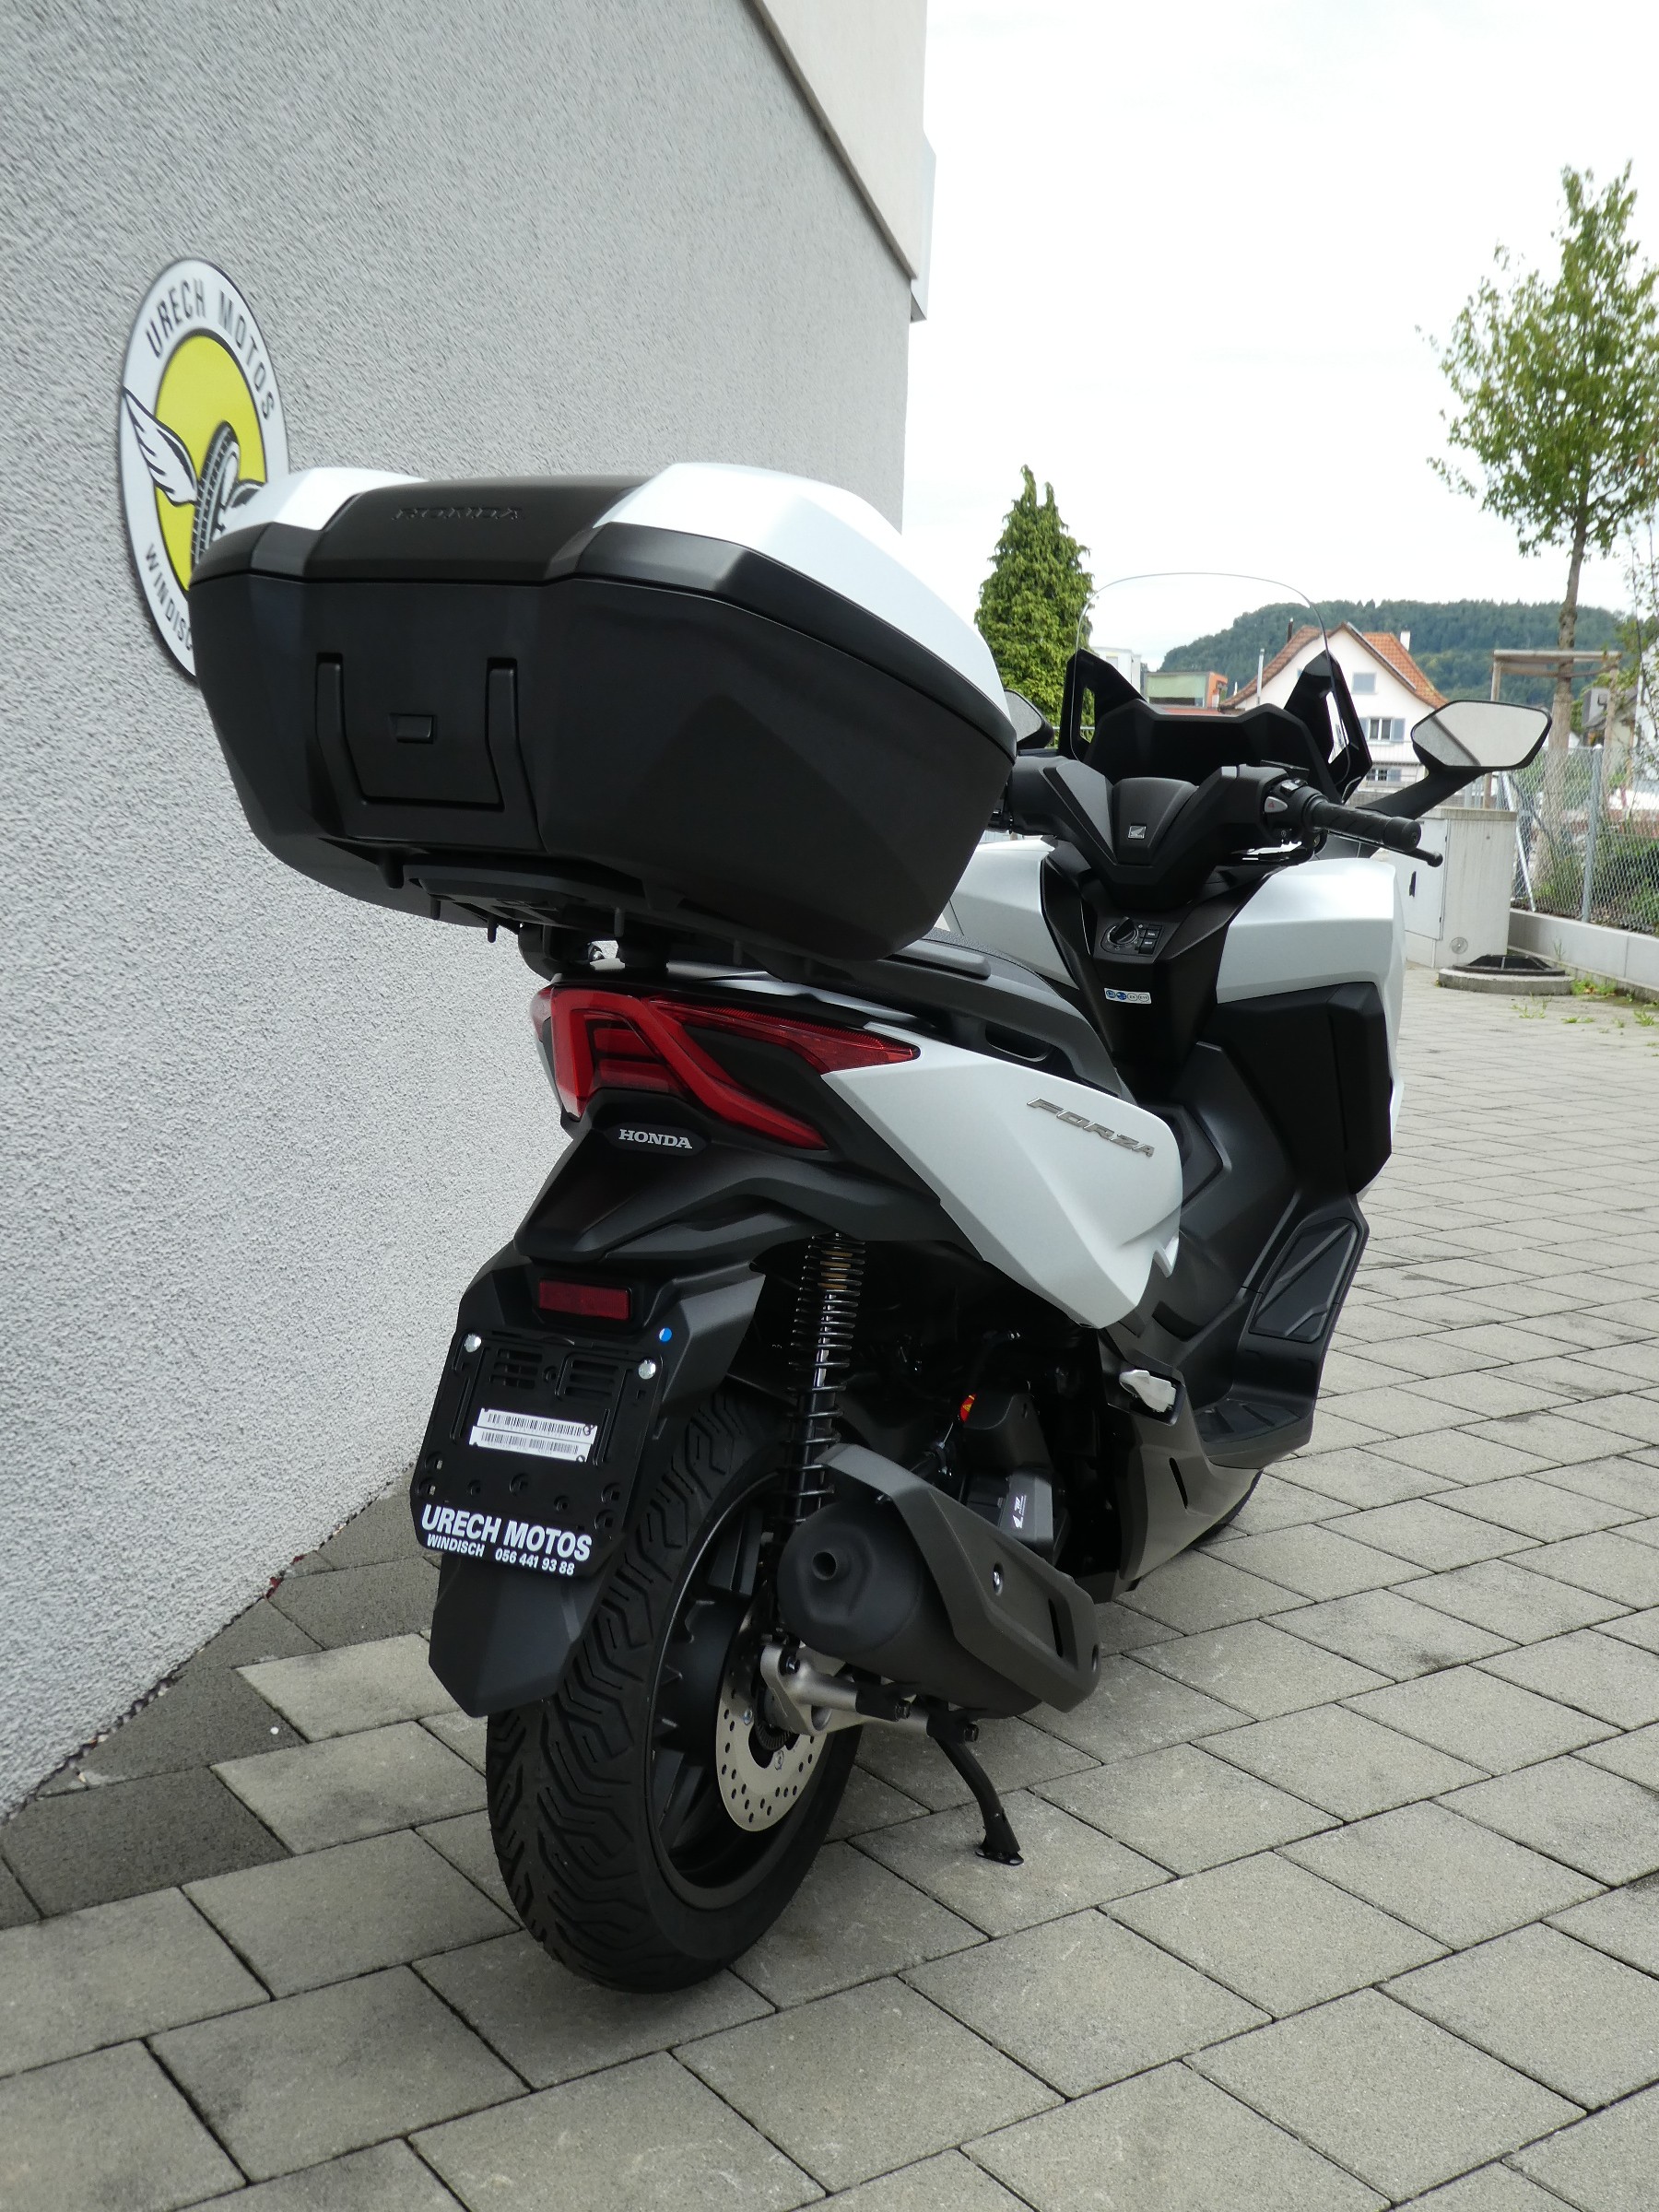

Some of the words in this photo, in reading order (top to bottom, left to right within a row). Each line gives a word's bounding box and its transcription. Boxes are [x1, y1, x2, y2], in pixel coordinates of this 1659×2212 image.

[144, 278, 206, 359] URECH
[218, 290, 275, 421] MOTOS
[146, 543, 193, 651] WINDISC
[618, 1128, 693, 1149] HONDA
[1027, 1098, 1155, 1158] FORZA
[421, 1504, 502, 1544] URECH
[503, 1520, 593, 1562] MOTOS
[427, 1534, 485, 1558] WINDISCH
[495, 1547, 517, 1564] 056
[519, 1553, 539, 1569] 441
[541, 1558, 558, 1572] 93
[559, 1560, 575, 1576] 88
